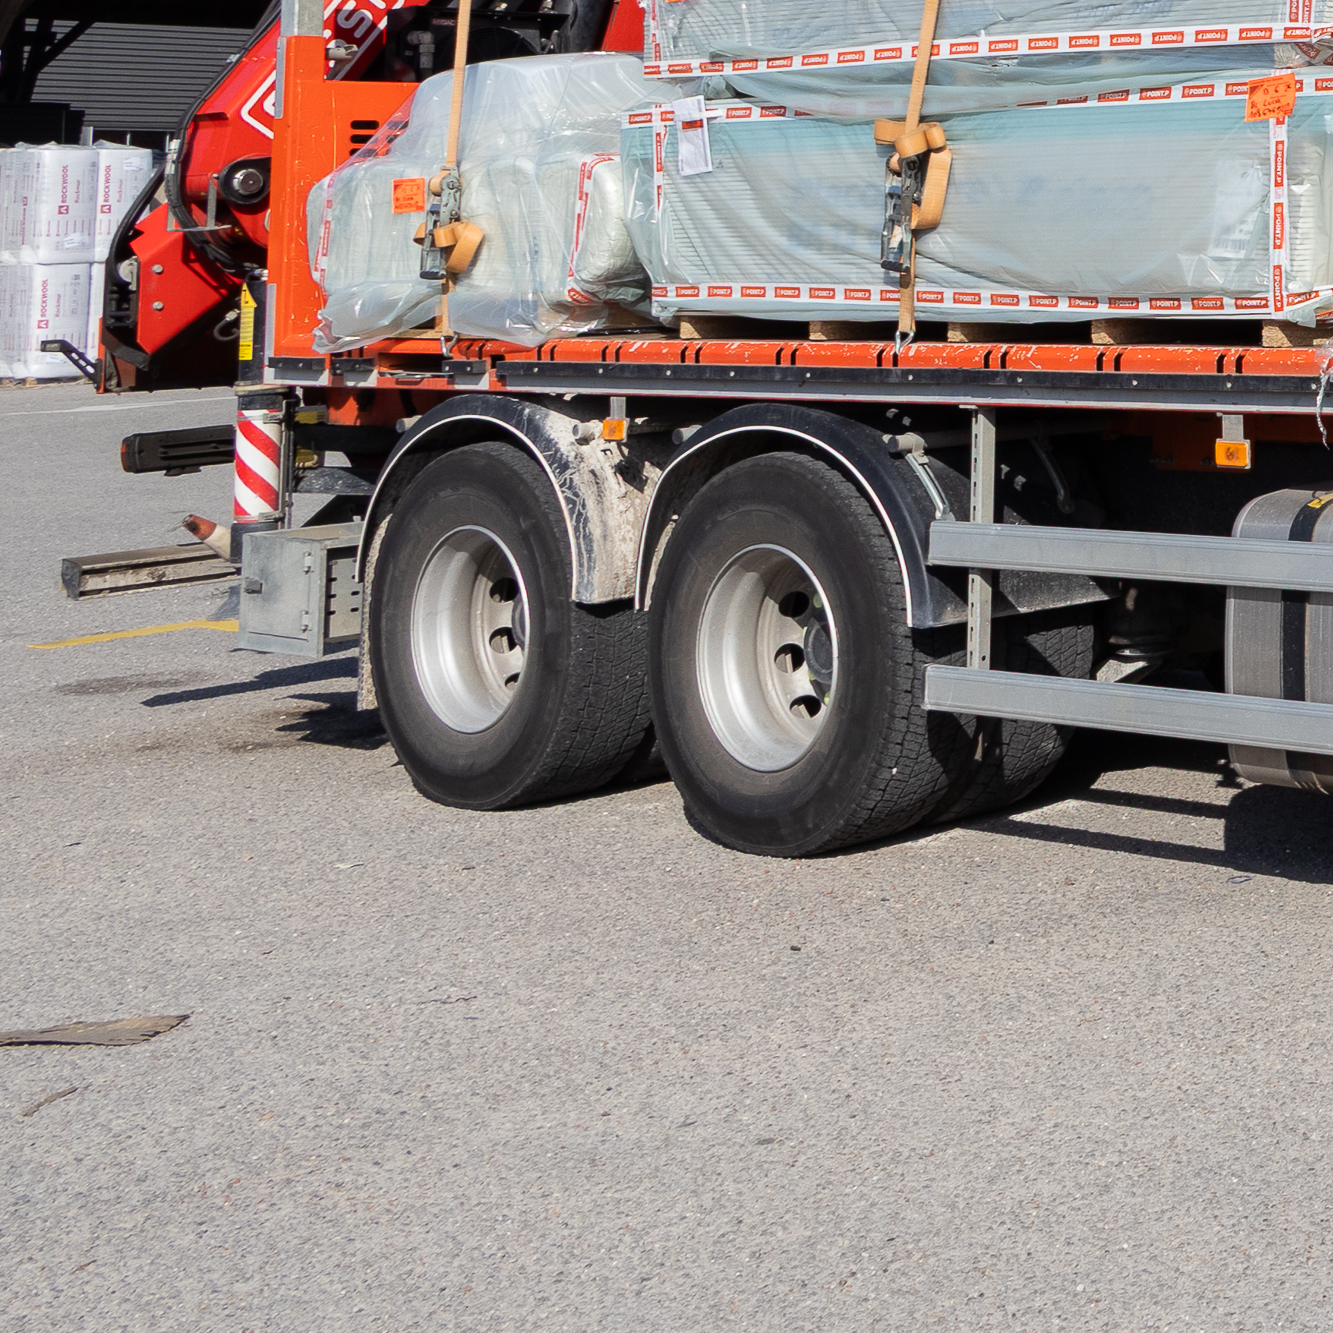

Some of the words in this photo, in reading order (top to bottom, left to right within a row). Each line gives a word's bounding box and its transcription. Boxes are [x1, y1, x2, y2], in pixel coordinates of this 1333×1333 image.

[61, 164, 69, 203] ROCKWOOL
[103, 164, 111, 203] ROCKWOOL
[40, 279, 48, 318] ROCKWOOL
